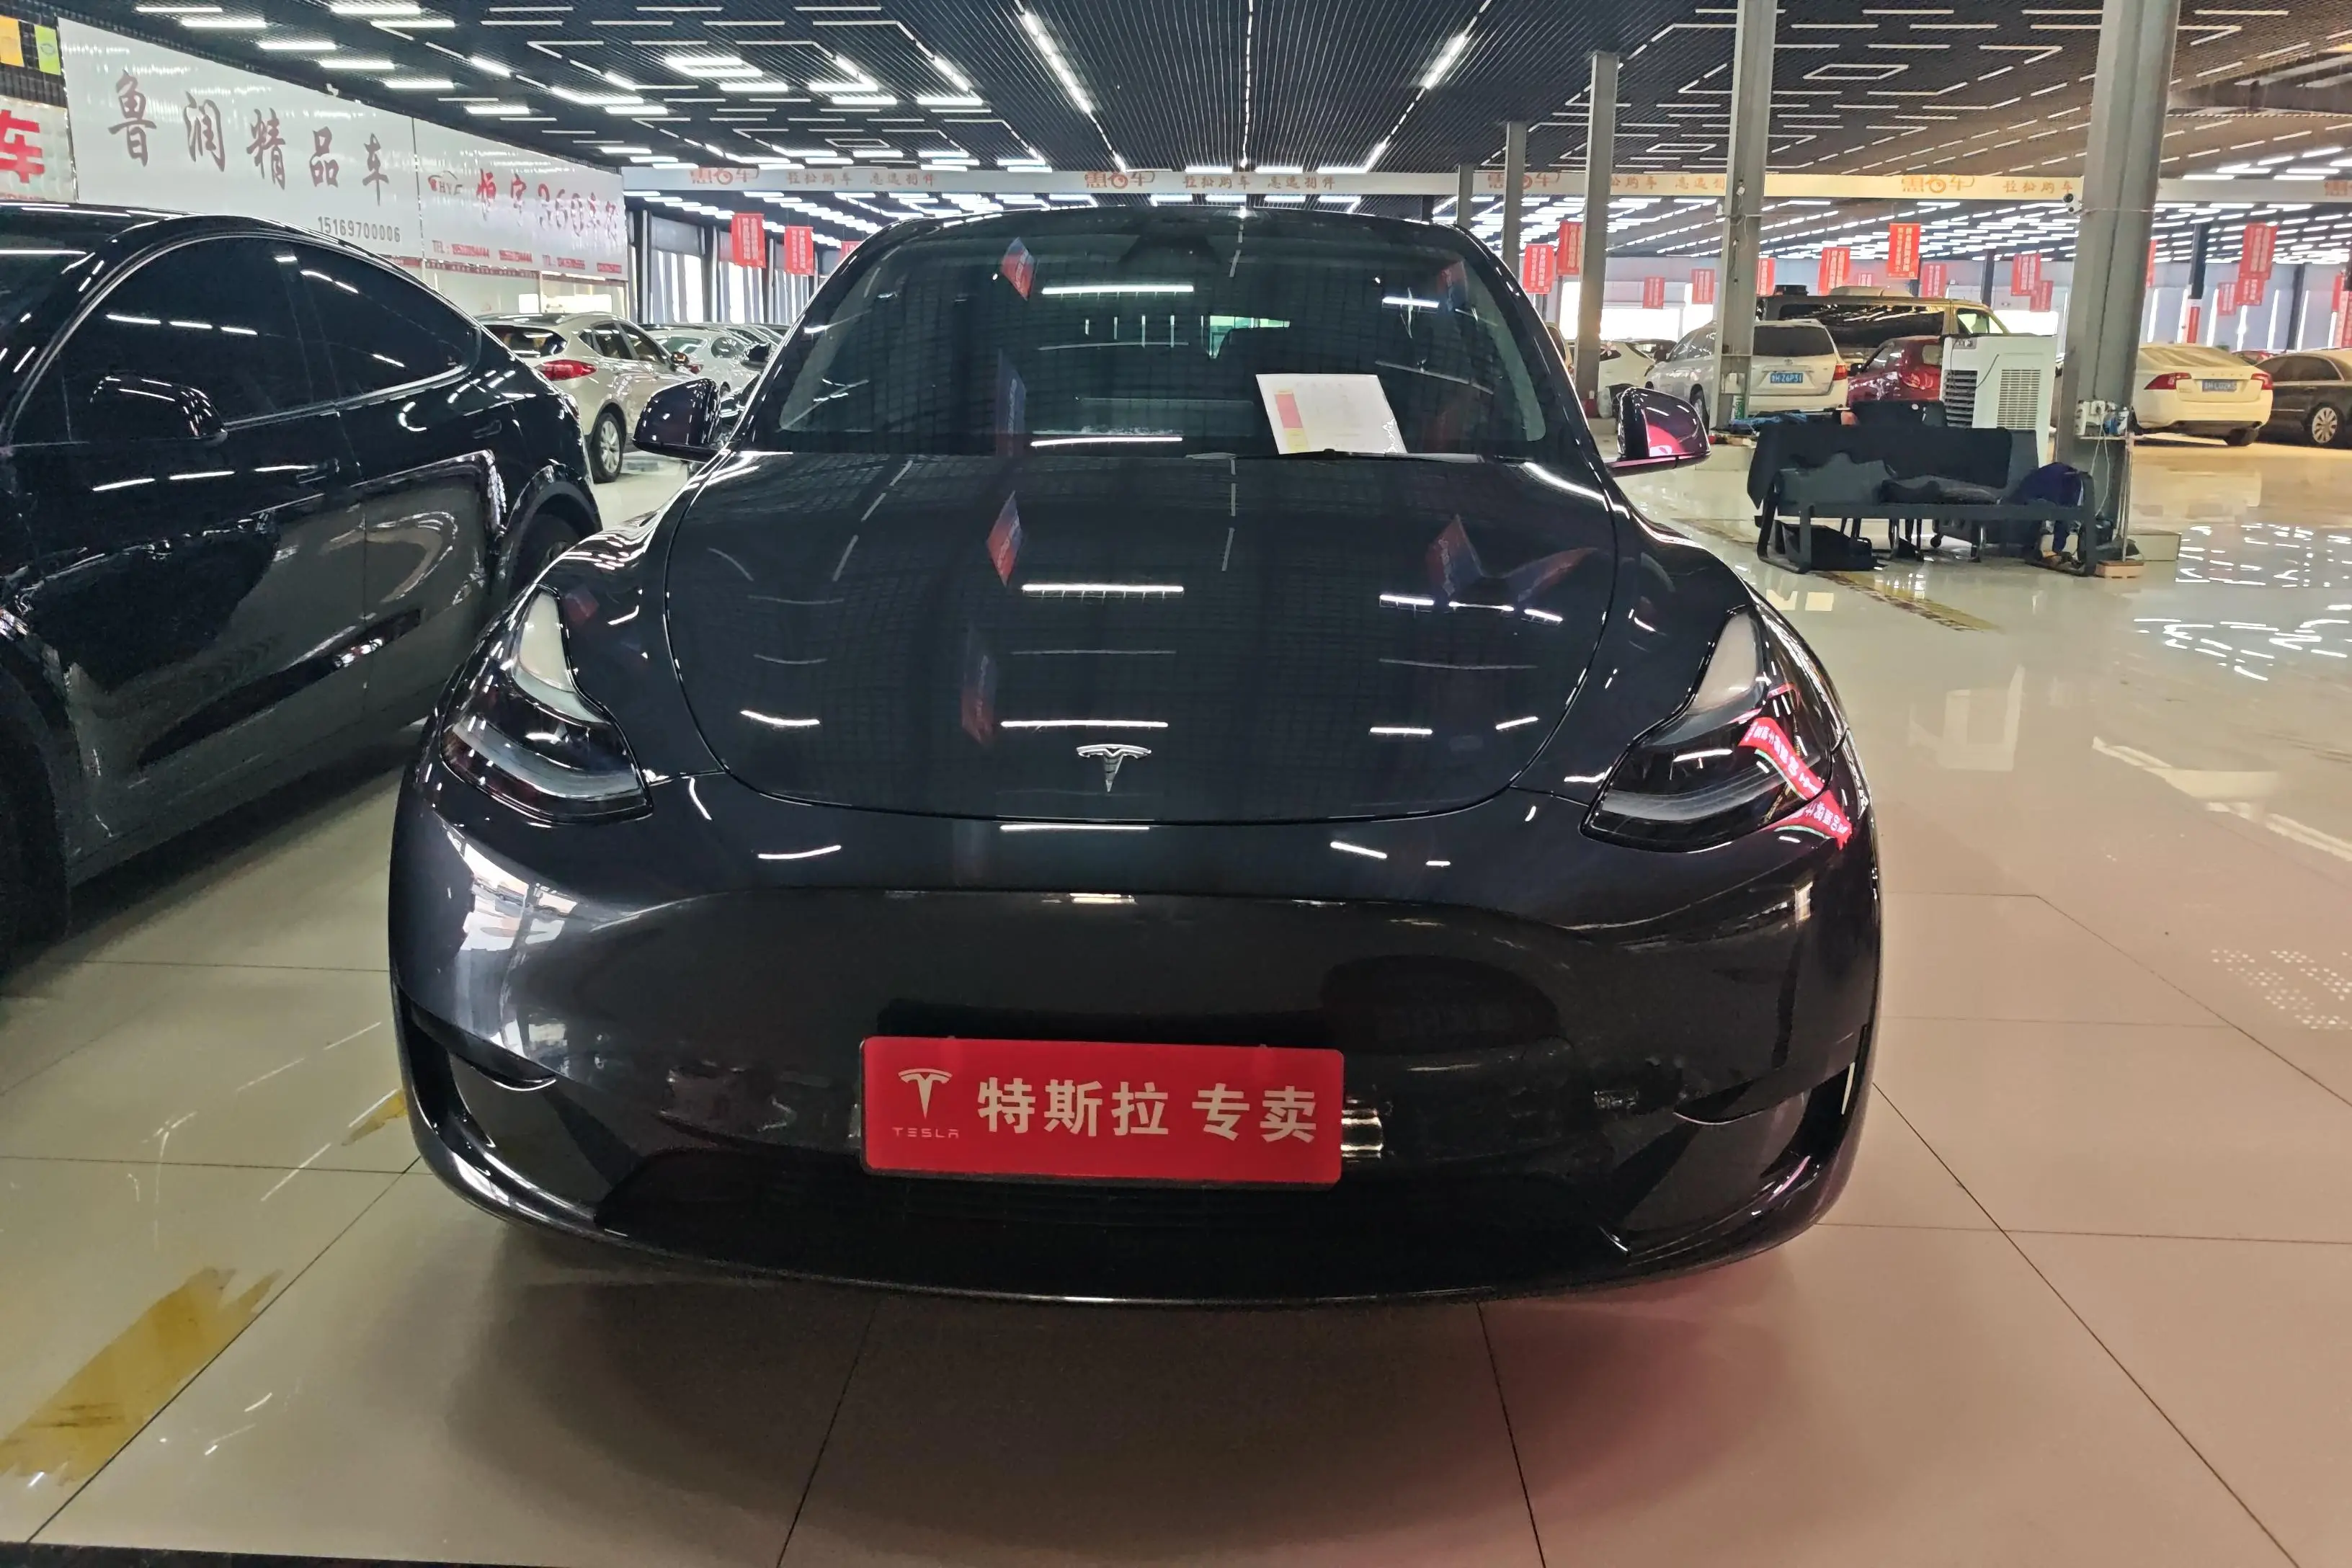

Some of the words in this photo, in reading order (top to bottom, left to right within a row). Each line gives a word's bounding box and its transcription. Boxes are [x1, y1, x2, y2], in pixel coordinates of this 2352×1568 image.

[108, 69, 389, 206] 鲁润精品车
[318, 215, 401, 243] 15169700006
[891, 1126, 959, 1139] TESLA
[977, 1077, 1169, 1137] 特斯拉
[1191, 1083, 1317, 1144] 专卖
